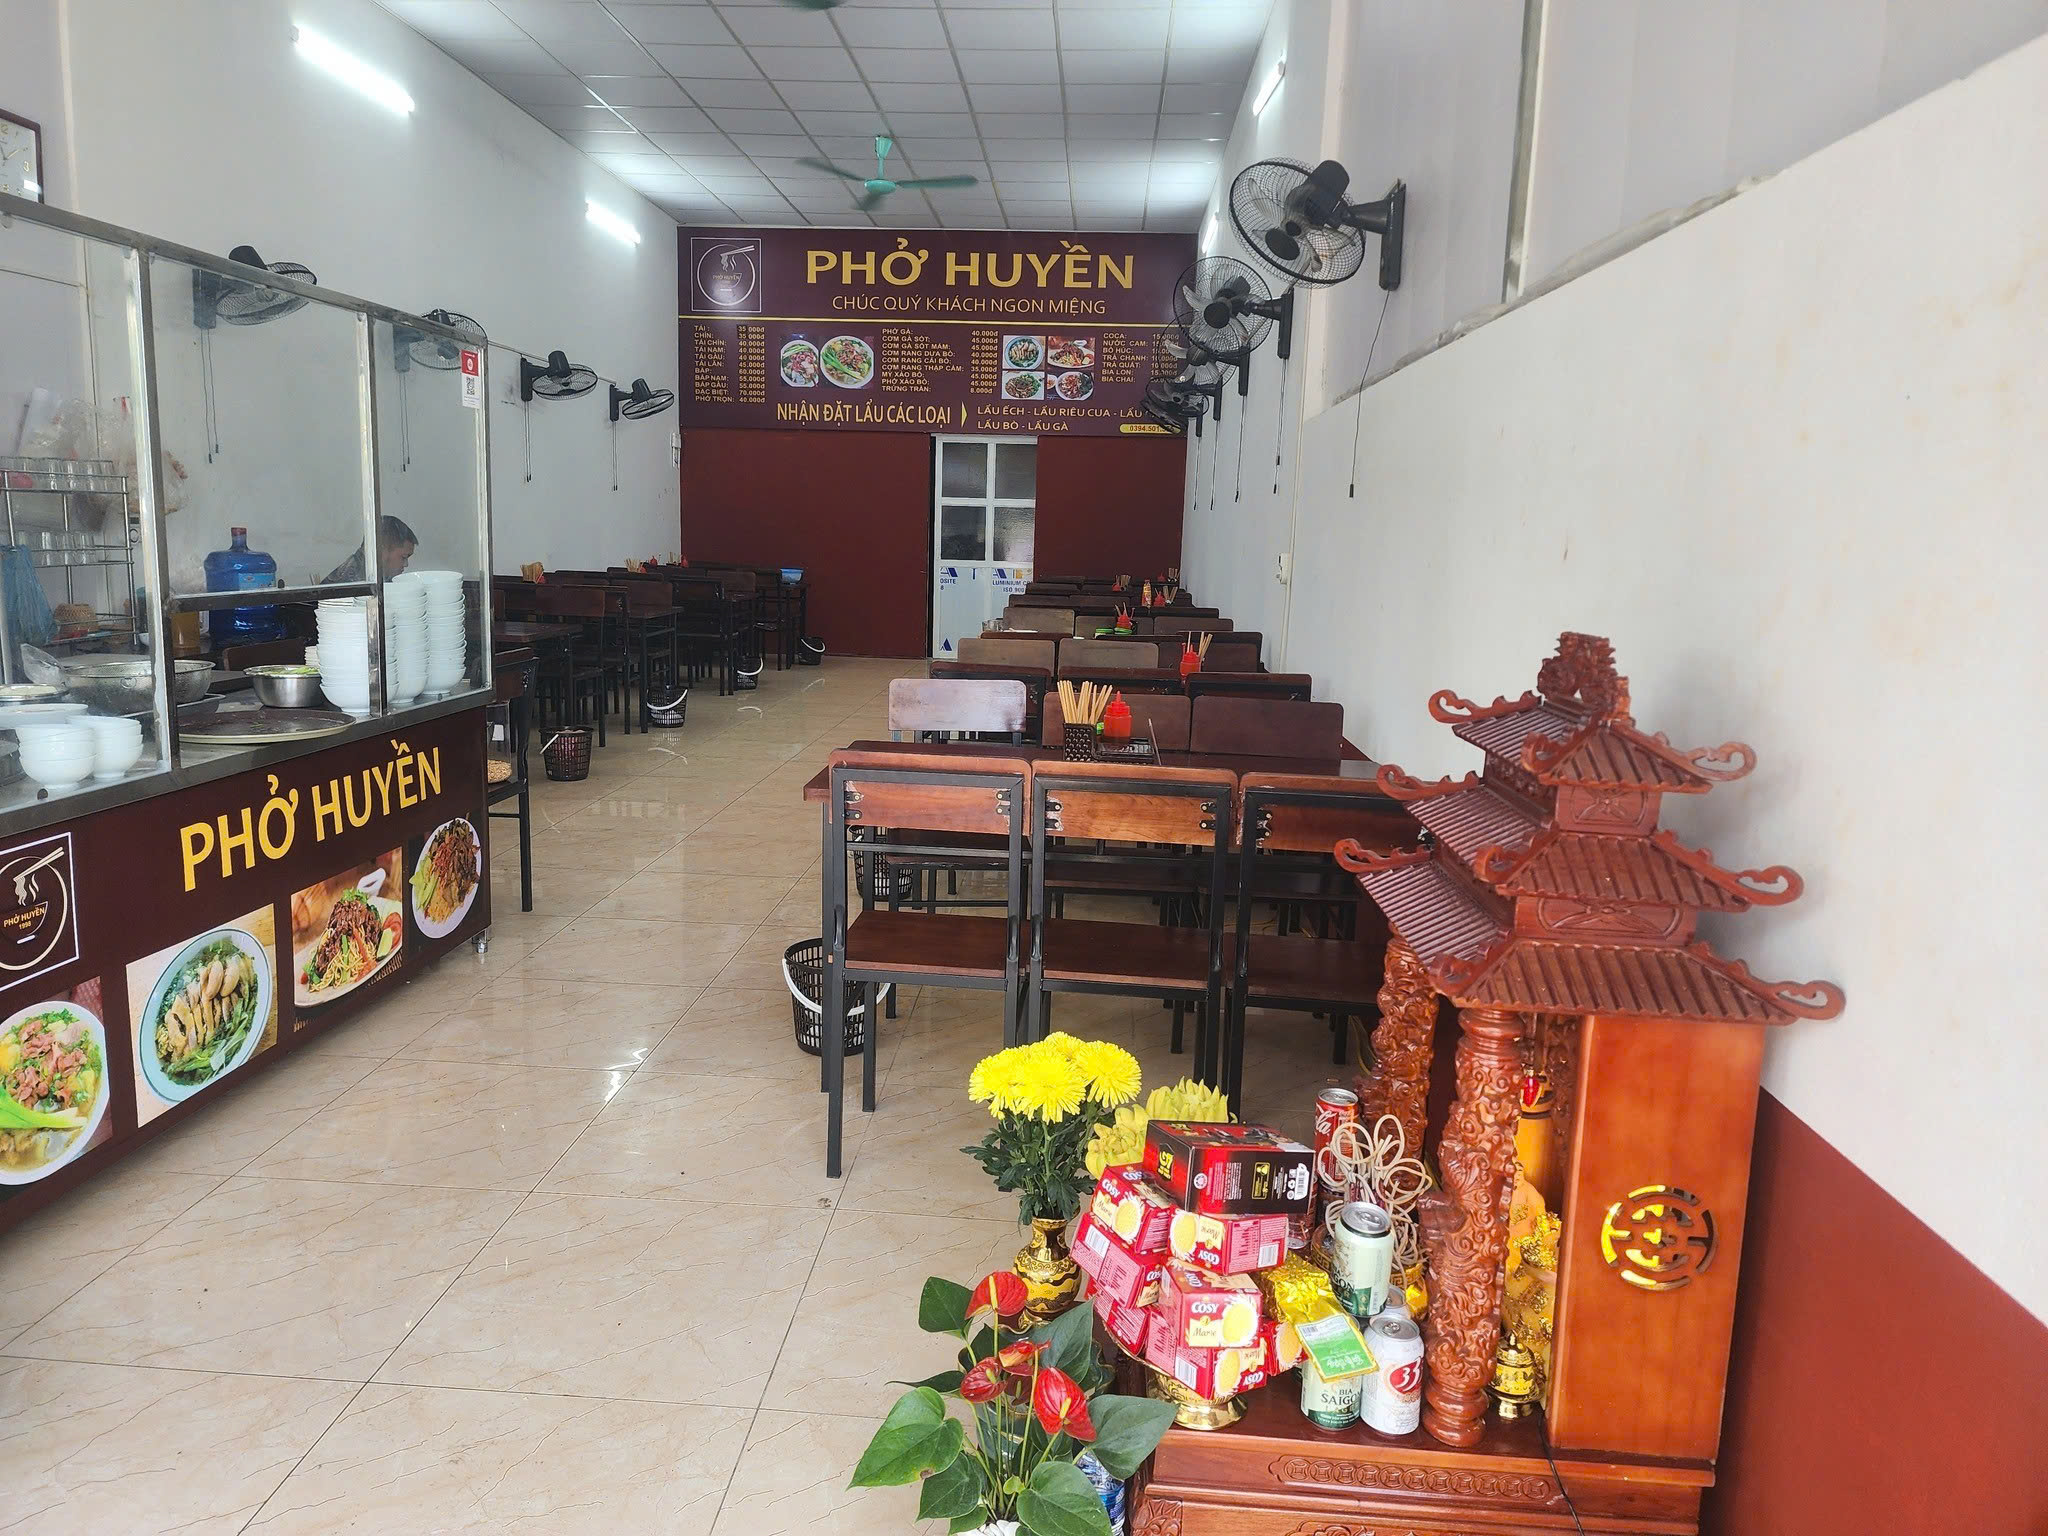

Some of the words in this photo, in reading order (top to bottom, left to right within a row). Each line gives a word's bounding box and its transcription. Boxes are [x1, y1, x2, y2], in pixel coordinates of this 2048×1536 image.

[807, 237, 929, 286] PHỞ
[945, 240, 1134, 289] HUYỀN
[832, 293, 880, 311] CHÚC
[883, 293, 921, 312] QUÝ
[926, 294, 986, 312] KHÁCH
[991, 298, 1044, 313] NGON
[1049, 296, 1106, 316] MIỆNG
[777, 400, 819, 425] NHẬN
[823, 401, 852, 427] ĐẶT
[855, 399, 884, 423] LẨU
[886, 401, 915, 424] CÁC
[918, 405, 951, 428] LOẠI
[1059, 406, 1085, 417] RIÊU
[1087, 408, 1111, 417] CUA
[1052, 421, 1069, 431] GÀ
[179, 774, 299, 892] PHỞ
[311, 739, 442, 842] HUYỀN
[3, 913, 20, 928] PHỞ
[21, 906, 45, 921] HUYỀN
[19, 920, 32, 929] 1998
[1101, 1178, 1121, 1198] COSY
[1146, 1270, 1162, 1282] COS
[1191, 1301, 1219, 1314] COSY
